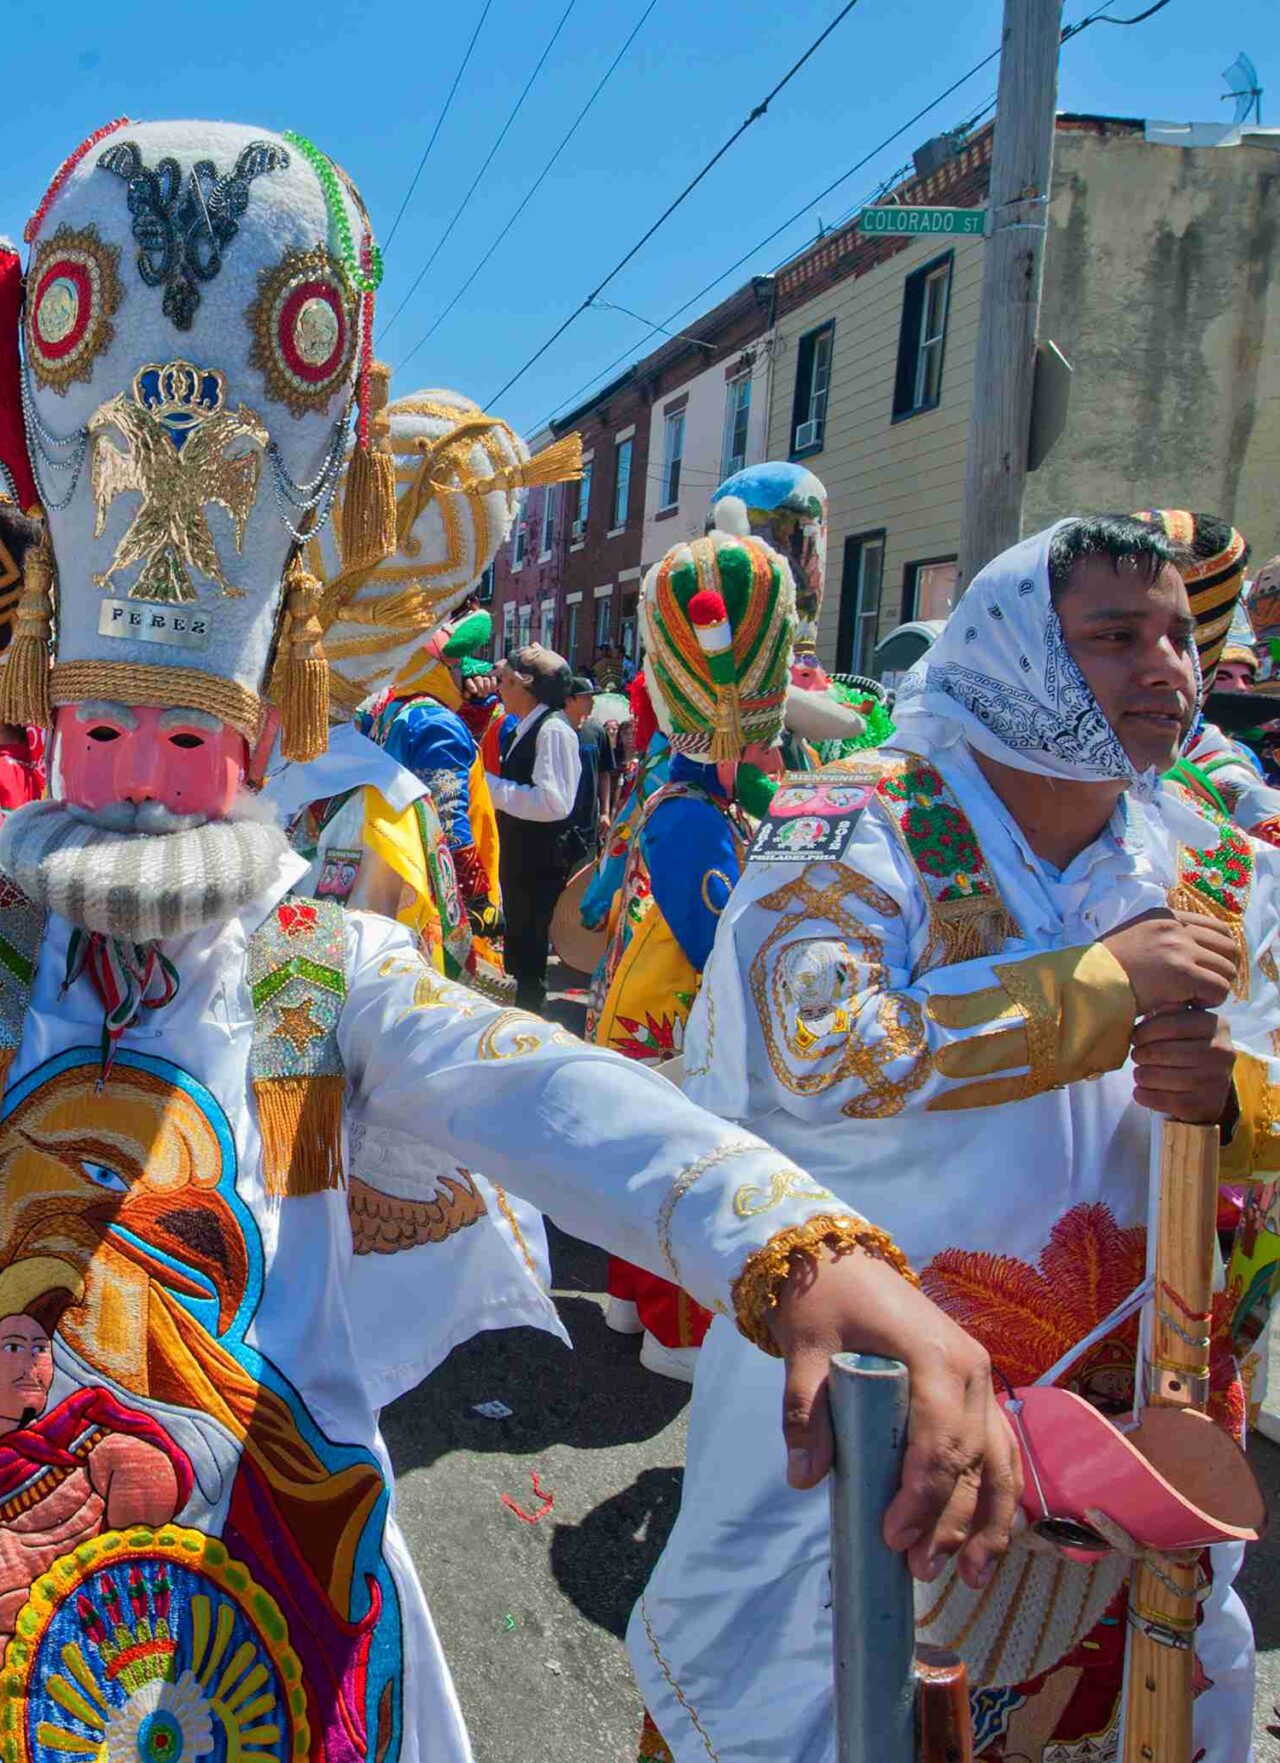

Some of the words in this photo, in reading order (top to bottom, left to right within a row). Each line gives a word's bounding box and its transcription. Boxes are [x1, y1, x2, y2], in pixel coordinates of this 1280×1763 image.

[864, 211, 954, 231] COLORADO
[963, 218, 979, 232] ST
[112, 607, 206, 634] PEREZ
